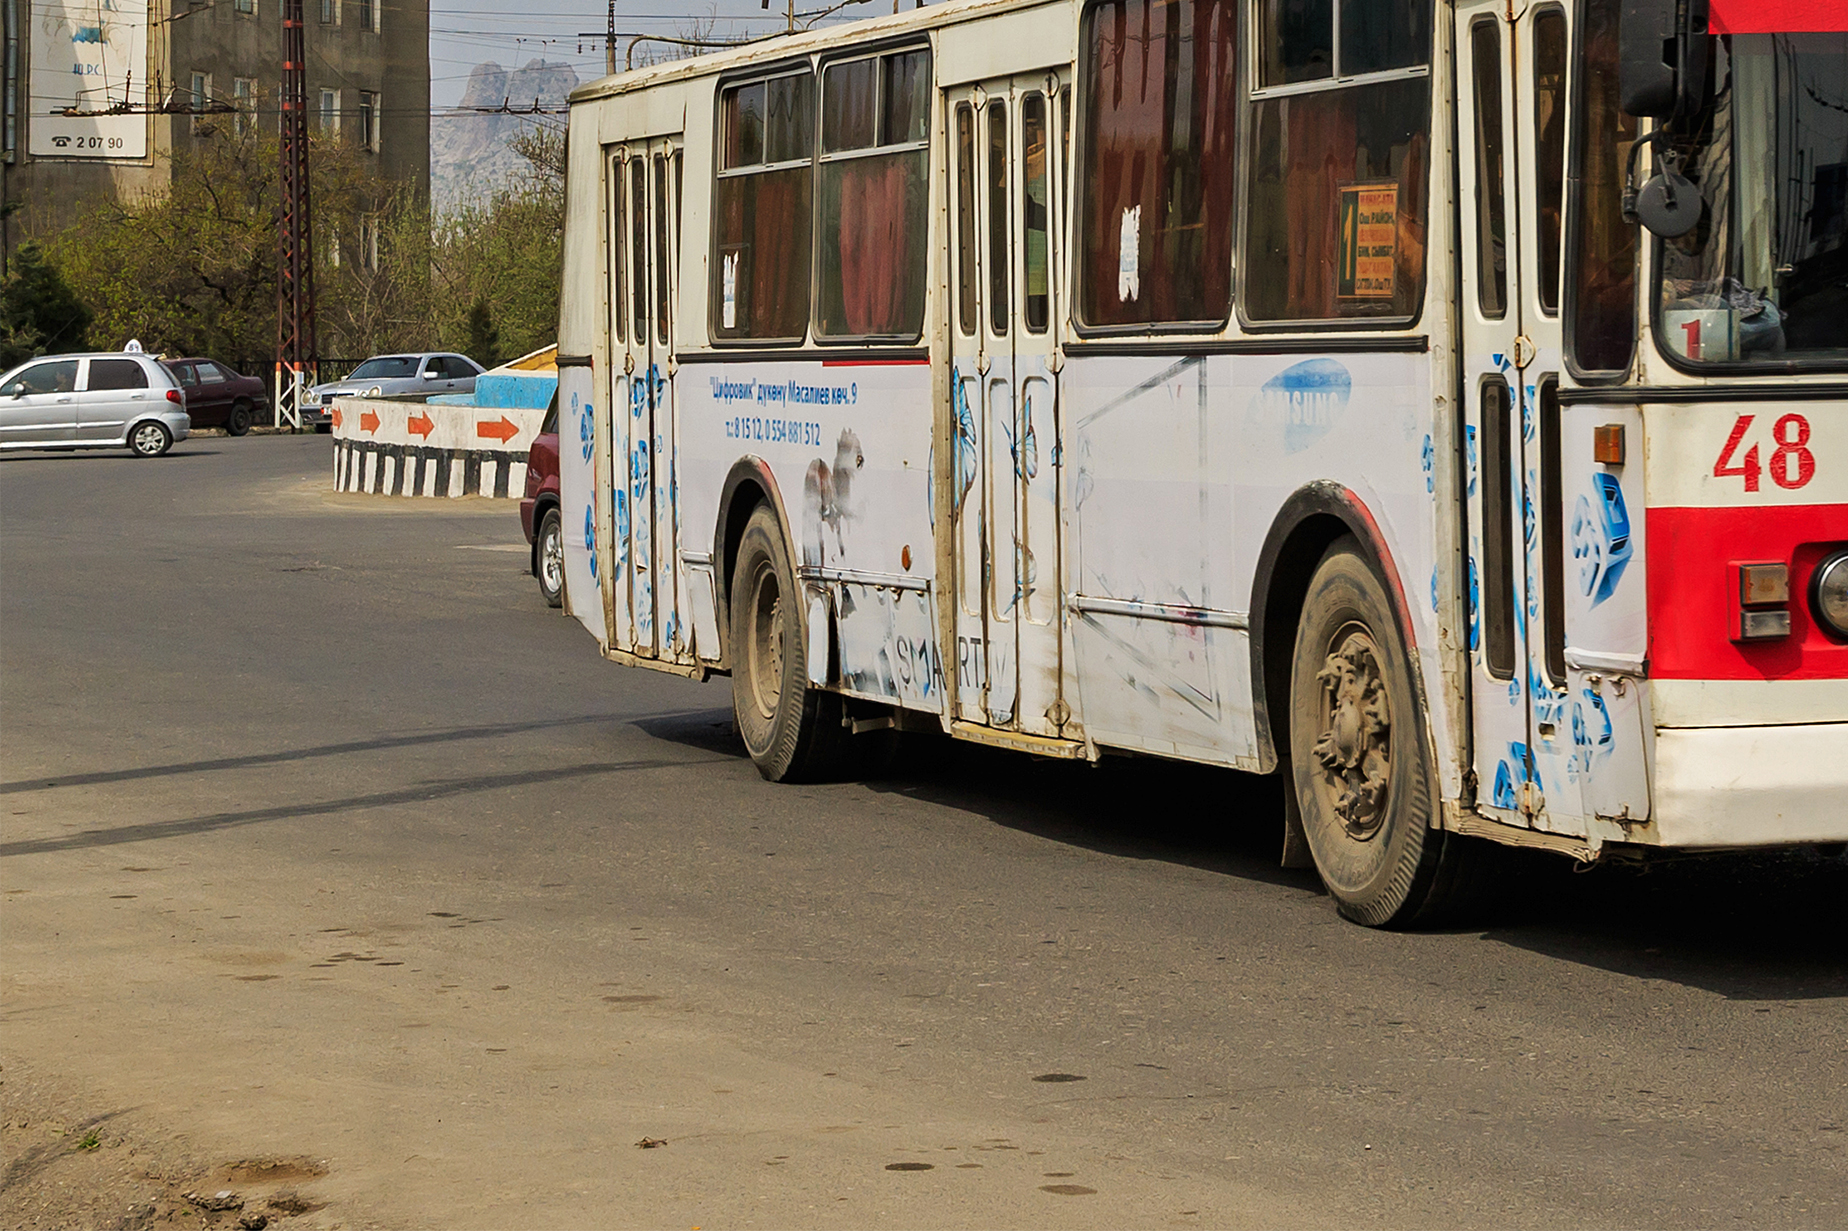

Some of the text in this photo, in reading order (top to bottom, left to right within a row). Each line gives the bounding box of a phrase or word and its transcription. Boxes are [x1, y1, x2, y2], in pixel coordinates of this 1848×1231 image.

[77, 136, 123, 149] 2 07 90
[1681, 319, 1704, 361] 1
[788, 380, 829, 405] Масалиев
[851, 382, 858, 405] 9
[734, 417, 740, 439] 8
[741, 418, 750, 439] 15
[765, 419, 770, 440] 0
[772, 420, 786, 442] 554
[788, 421, 802, 443] 881
[805, 422, 820, 446] 512
[1713, 413, 1816, 493] 48
